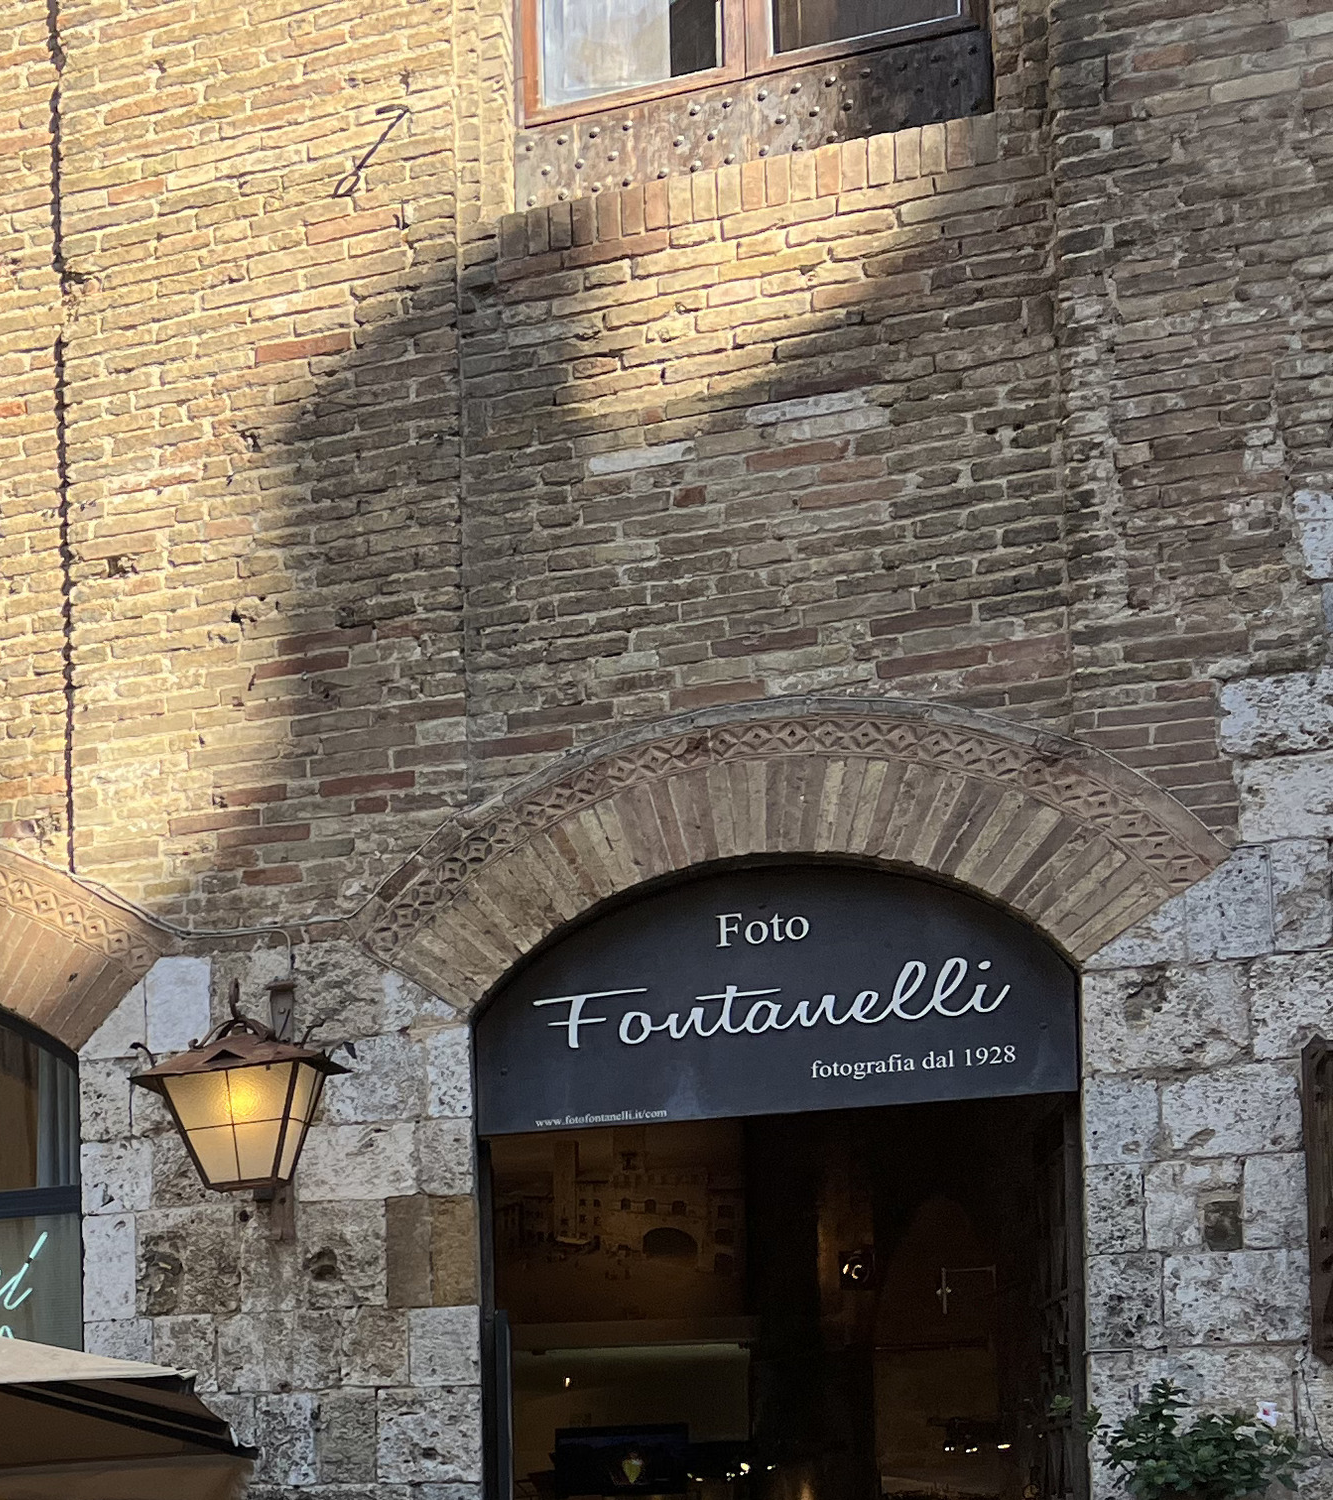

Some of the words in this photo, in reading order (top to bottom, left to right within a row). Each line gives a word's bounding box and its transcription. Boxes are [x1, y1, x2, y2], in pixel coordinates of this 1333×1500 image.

[715, 911, 810, 948] Foto
[533, 956, 1011, 1050] Fontanelli
[810, 1054, 915, 1080] fotografia
[922, 1050, 955, 1070] dal
[965, 1044, 1017, 1067] 1928
